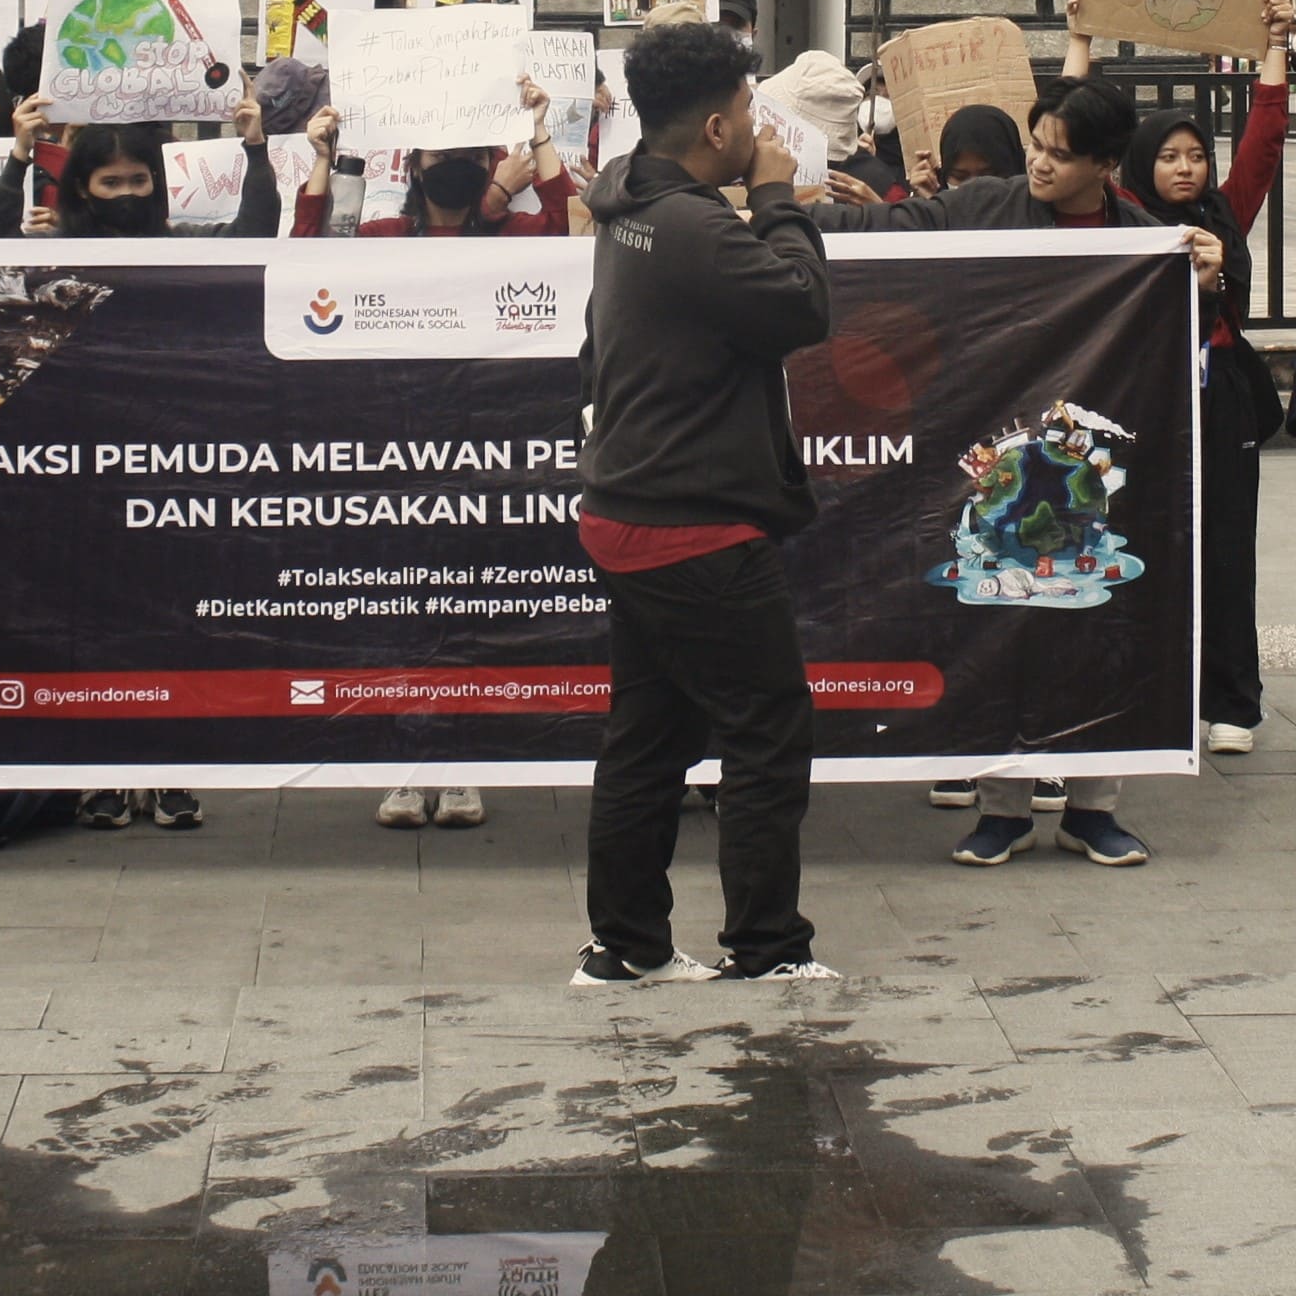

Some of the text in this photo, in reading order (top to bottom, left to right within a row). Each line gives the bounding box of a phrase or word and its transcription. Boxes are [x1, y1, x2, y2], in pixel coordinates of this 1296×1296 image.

[135, 40, 211, 70] STOP
[542, 37, 588, 58] MAKAN
[53, 67, 202, 101] GLOBAL
[354, 293, 386, 308] IYES
[354, 307, 459, 319] INDONESIAN YOUTH
[354, 319, 467, 331] EDUCATION & SOCIAL
[94, 442, 282, 475] PEMUDA
[291, 440, 512, 473] MELAWAN
[803, 435, 914, 467] IKLIM
[125, 497, 216, 529] DAN
[231, 494, 487, 528] KERUSAKAN
[277, 564, 597, 588] #TolakSekaliPakai #ZeroWast
[195, 595, 612, 621] #DietKantongPlastik #KampanyeBeba
[33, 677, 915, 706] @iyesindonesia indonesianyouth.es@gmail.com ndonesia.org
